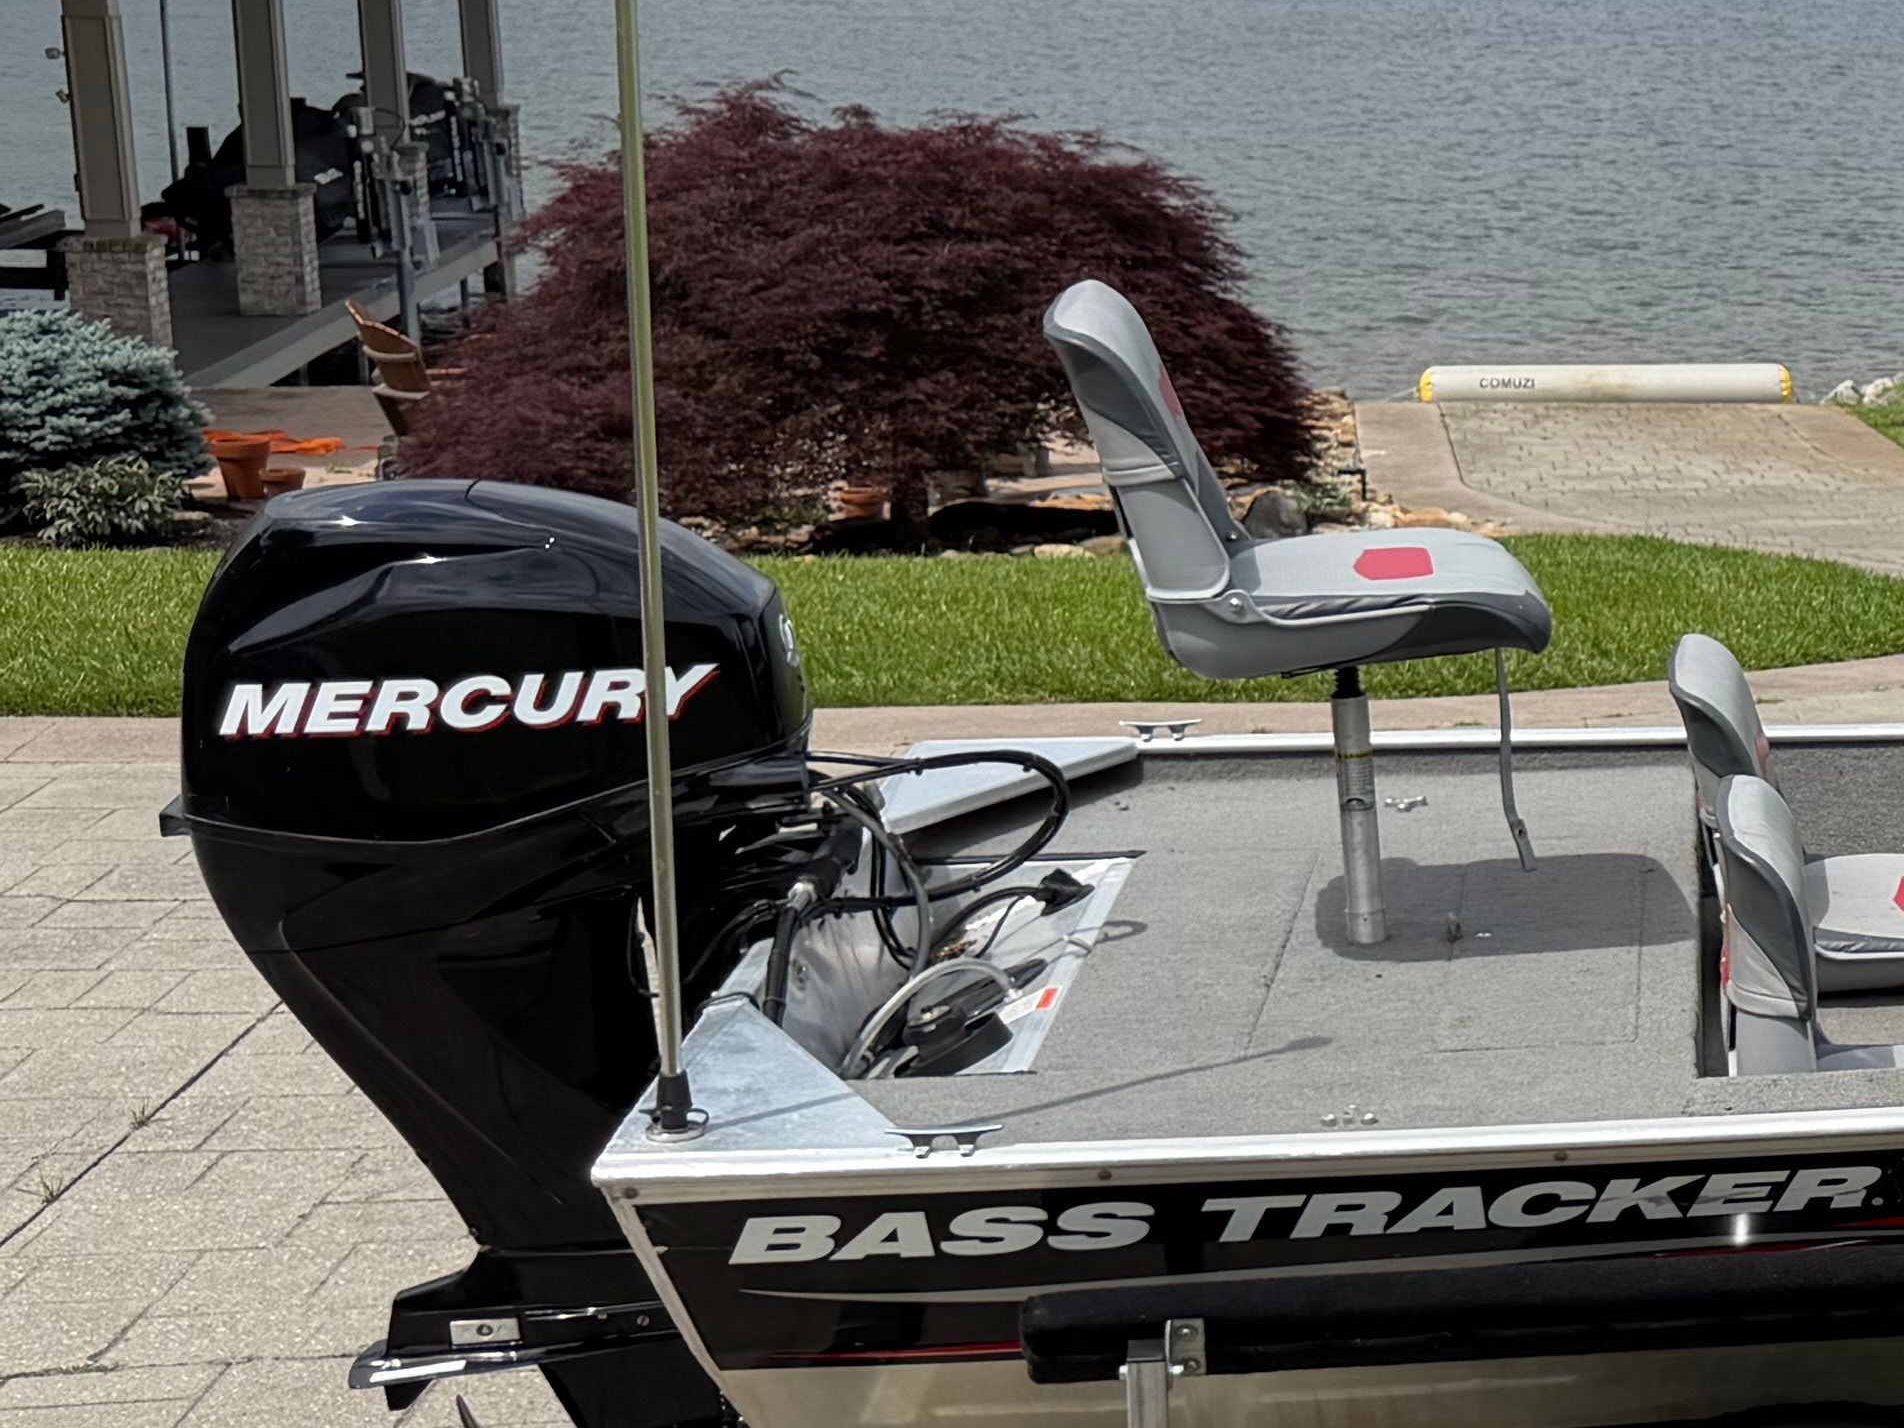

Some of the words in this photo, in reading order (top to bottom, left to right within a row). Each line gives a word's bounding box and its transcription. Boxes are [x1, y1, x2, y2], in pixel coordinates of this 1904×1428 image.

[1479, 377, 1536, 389] COMUZI
[218, 662, 720, 740] MERCURY
[728, 1200, 1154, 1267] BASS
[1202, 1165, 1884, 1245] TRACKER
